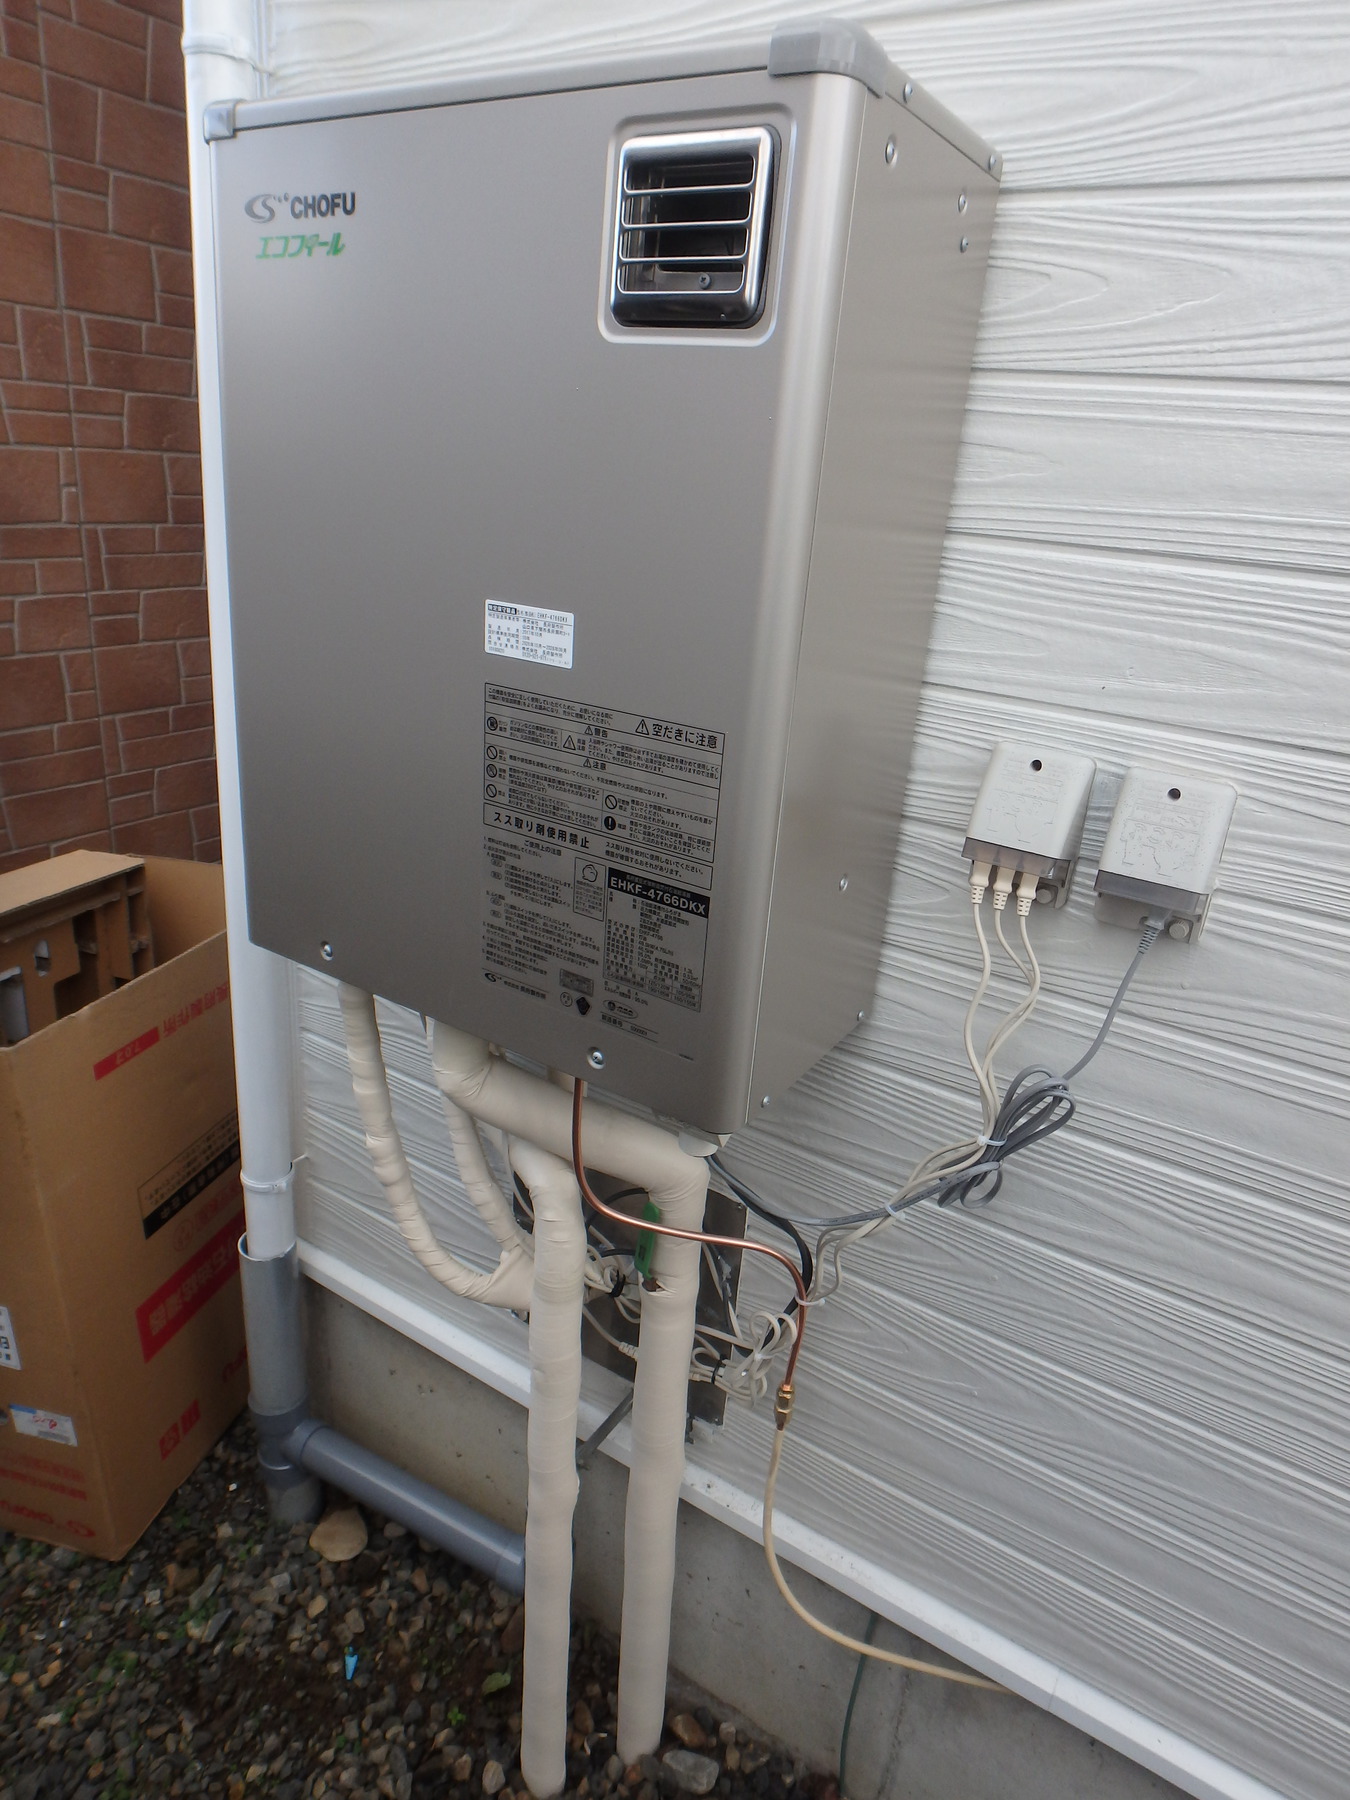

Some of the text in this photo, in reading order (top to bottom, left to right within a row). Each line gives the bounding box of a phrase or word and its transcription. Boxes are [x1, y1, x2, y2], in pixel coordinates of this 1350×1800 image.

[290, 192, 356, 219] CHOFU
[256, 232, 346, 259] エコフィール
[652, 723, 718, 749] 空だきに注意
[493, 811, 590, 849] スス取り剤使用禁止
[610, 876, 706, 915] EHKF-4766DKX
